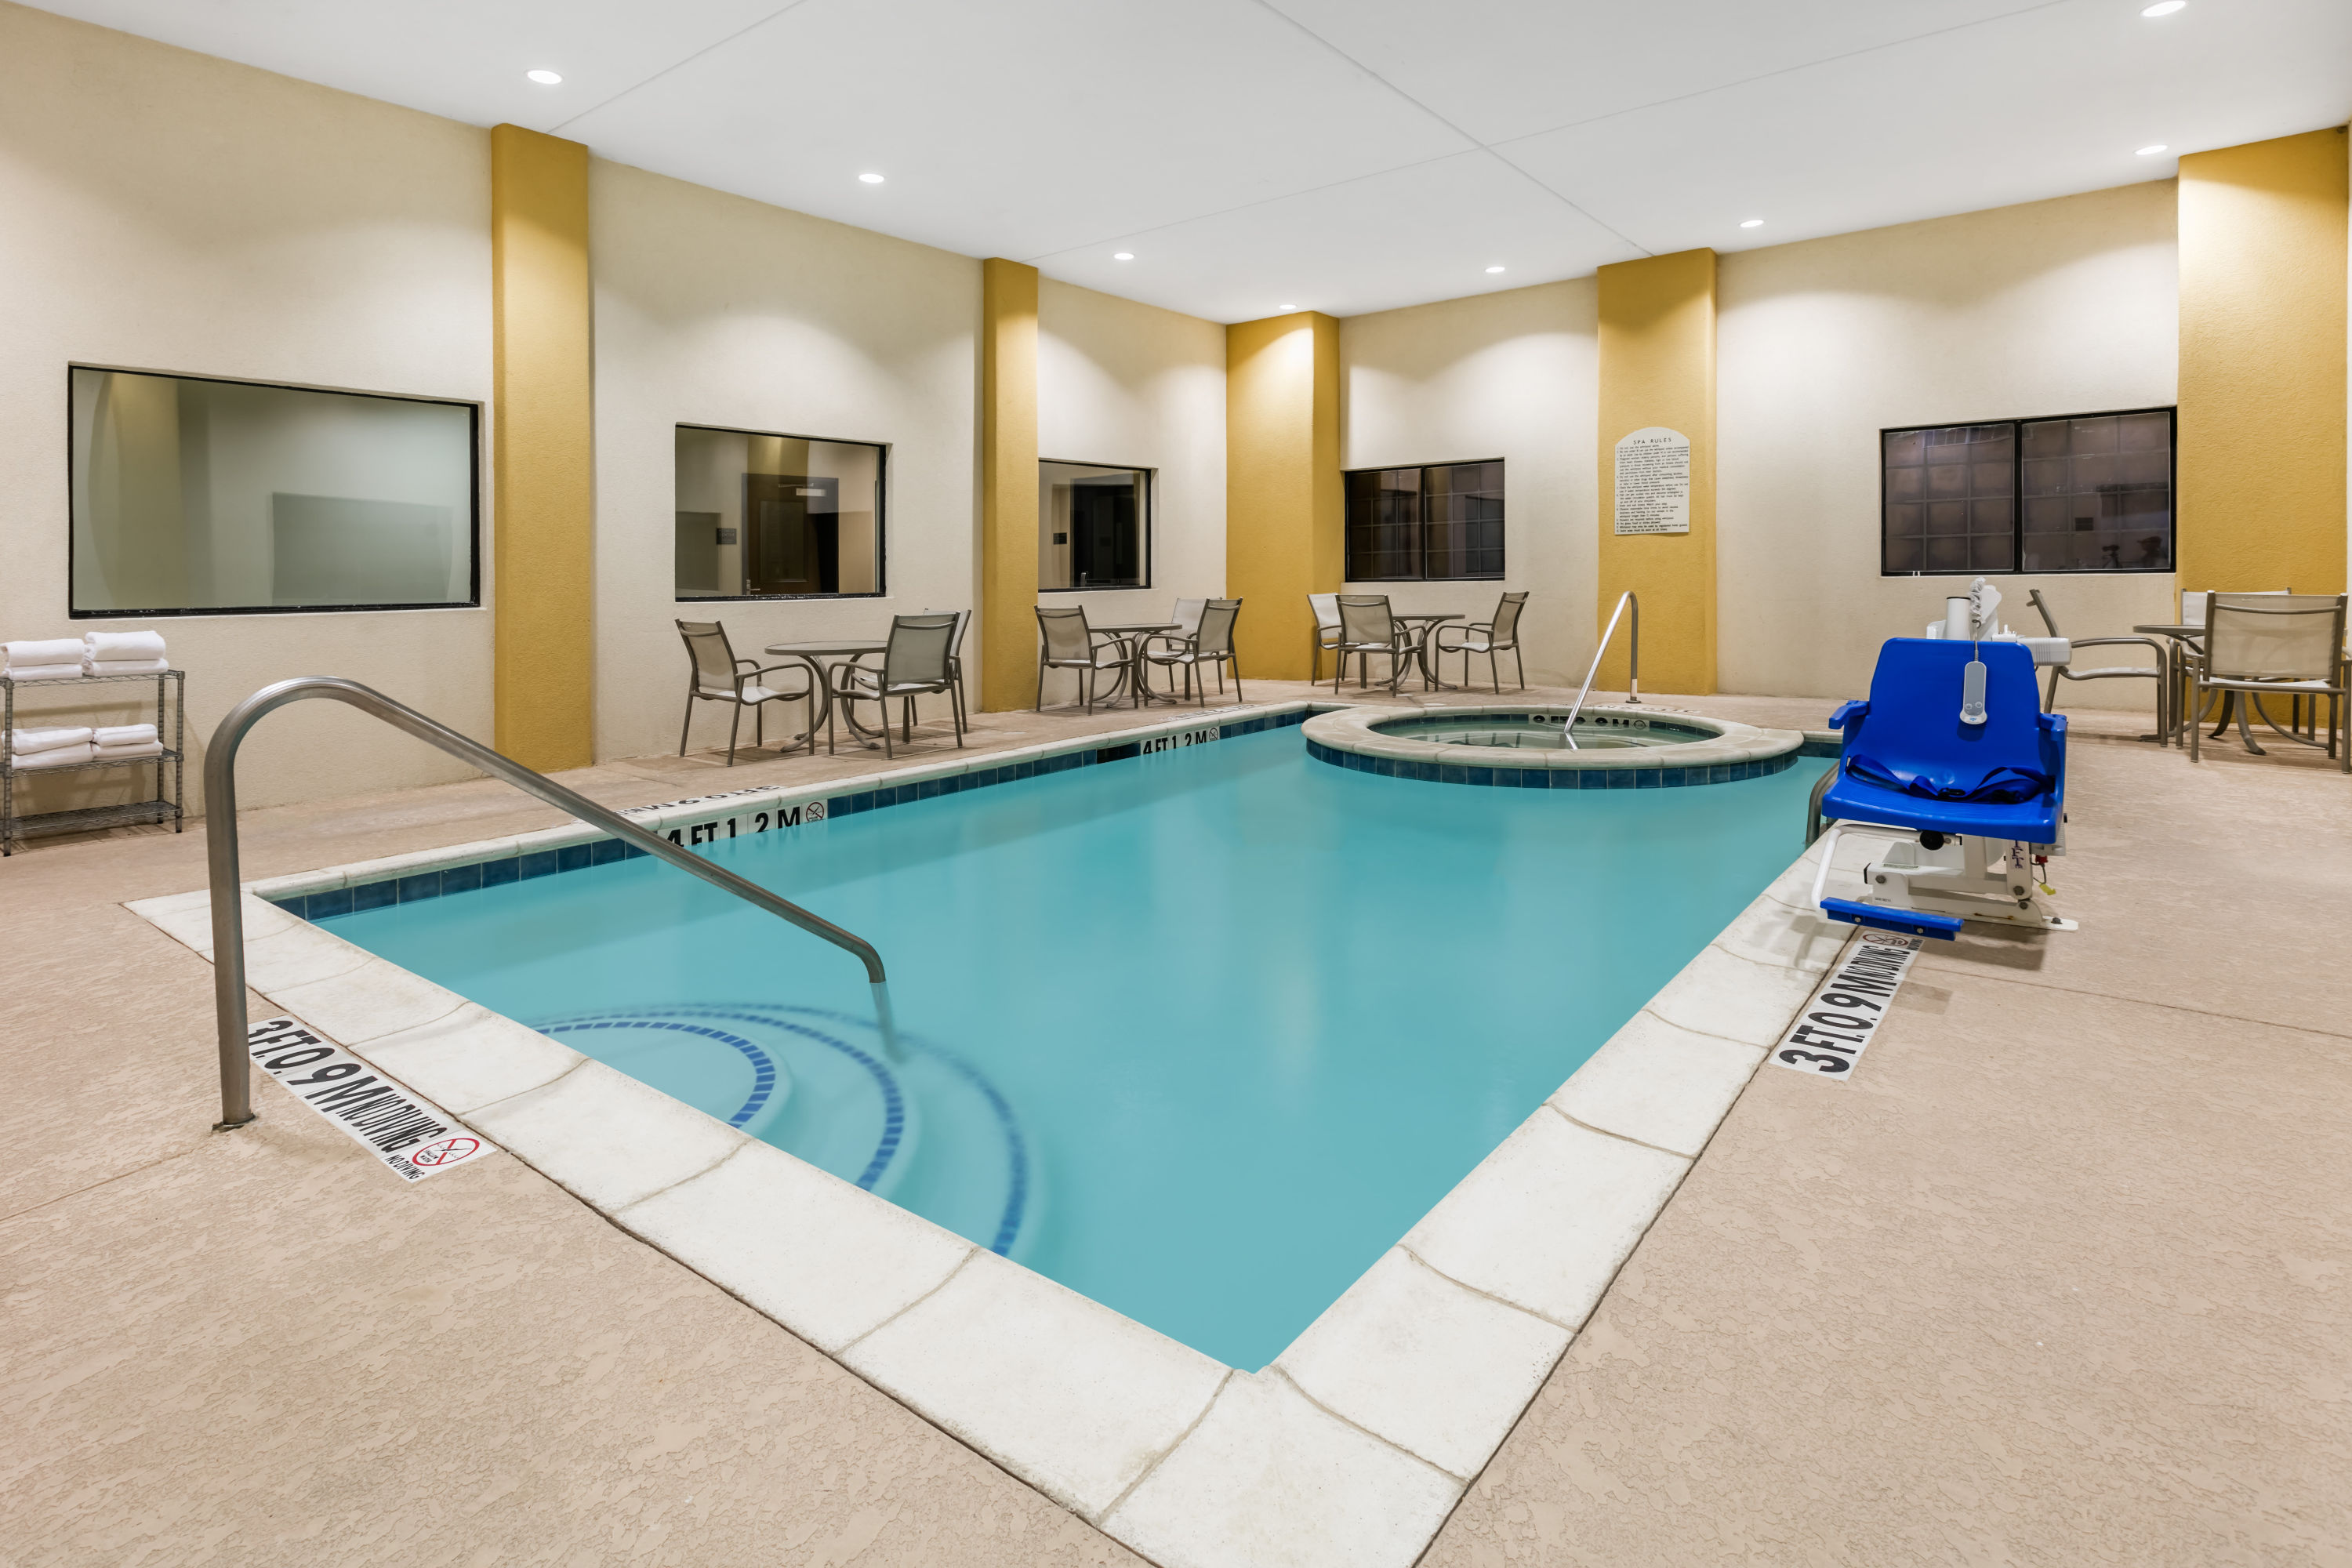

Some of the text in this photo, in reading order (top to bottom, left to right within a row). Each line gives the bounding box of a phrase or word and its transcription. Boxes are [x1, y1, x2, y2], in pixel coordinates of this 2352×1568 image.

[1143, 740, 1152, 754] 4
[1155, 737, 1168, 753] FT
[1196, 730, 1207, 744] M
[691, 822, 718, 846] FT
[778, 806, 800, 829] M
[350, 1103, 448, 1154] DIVING
[384, 1154, 426, 1180] NO DIVING
